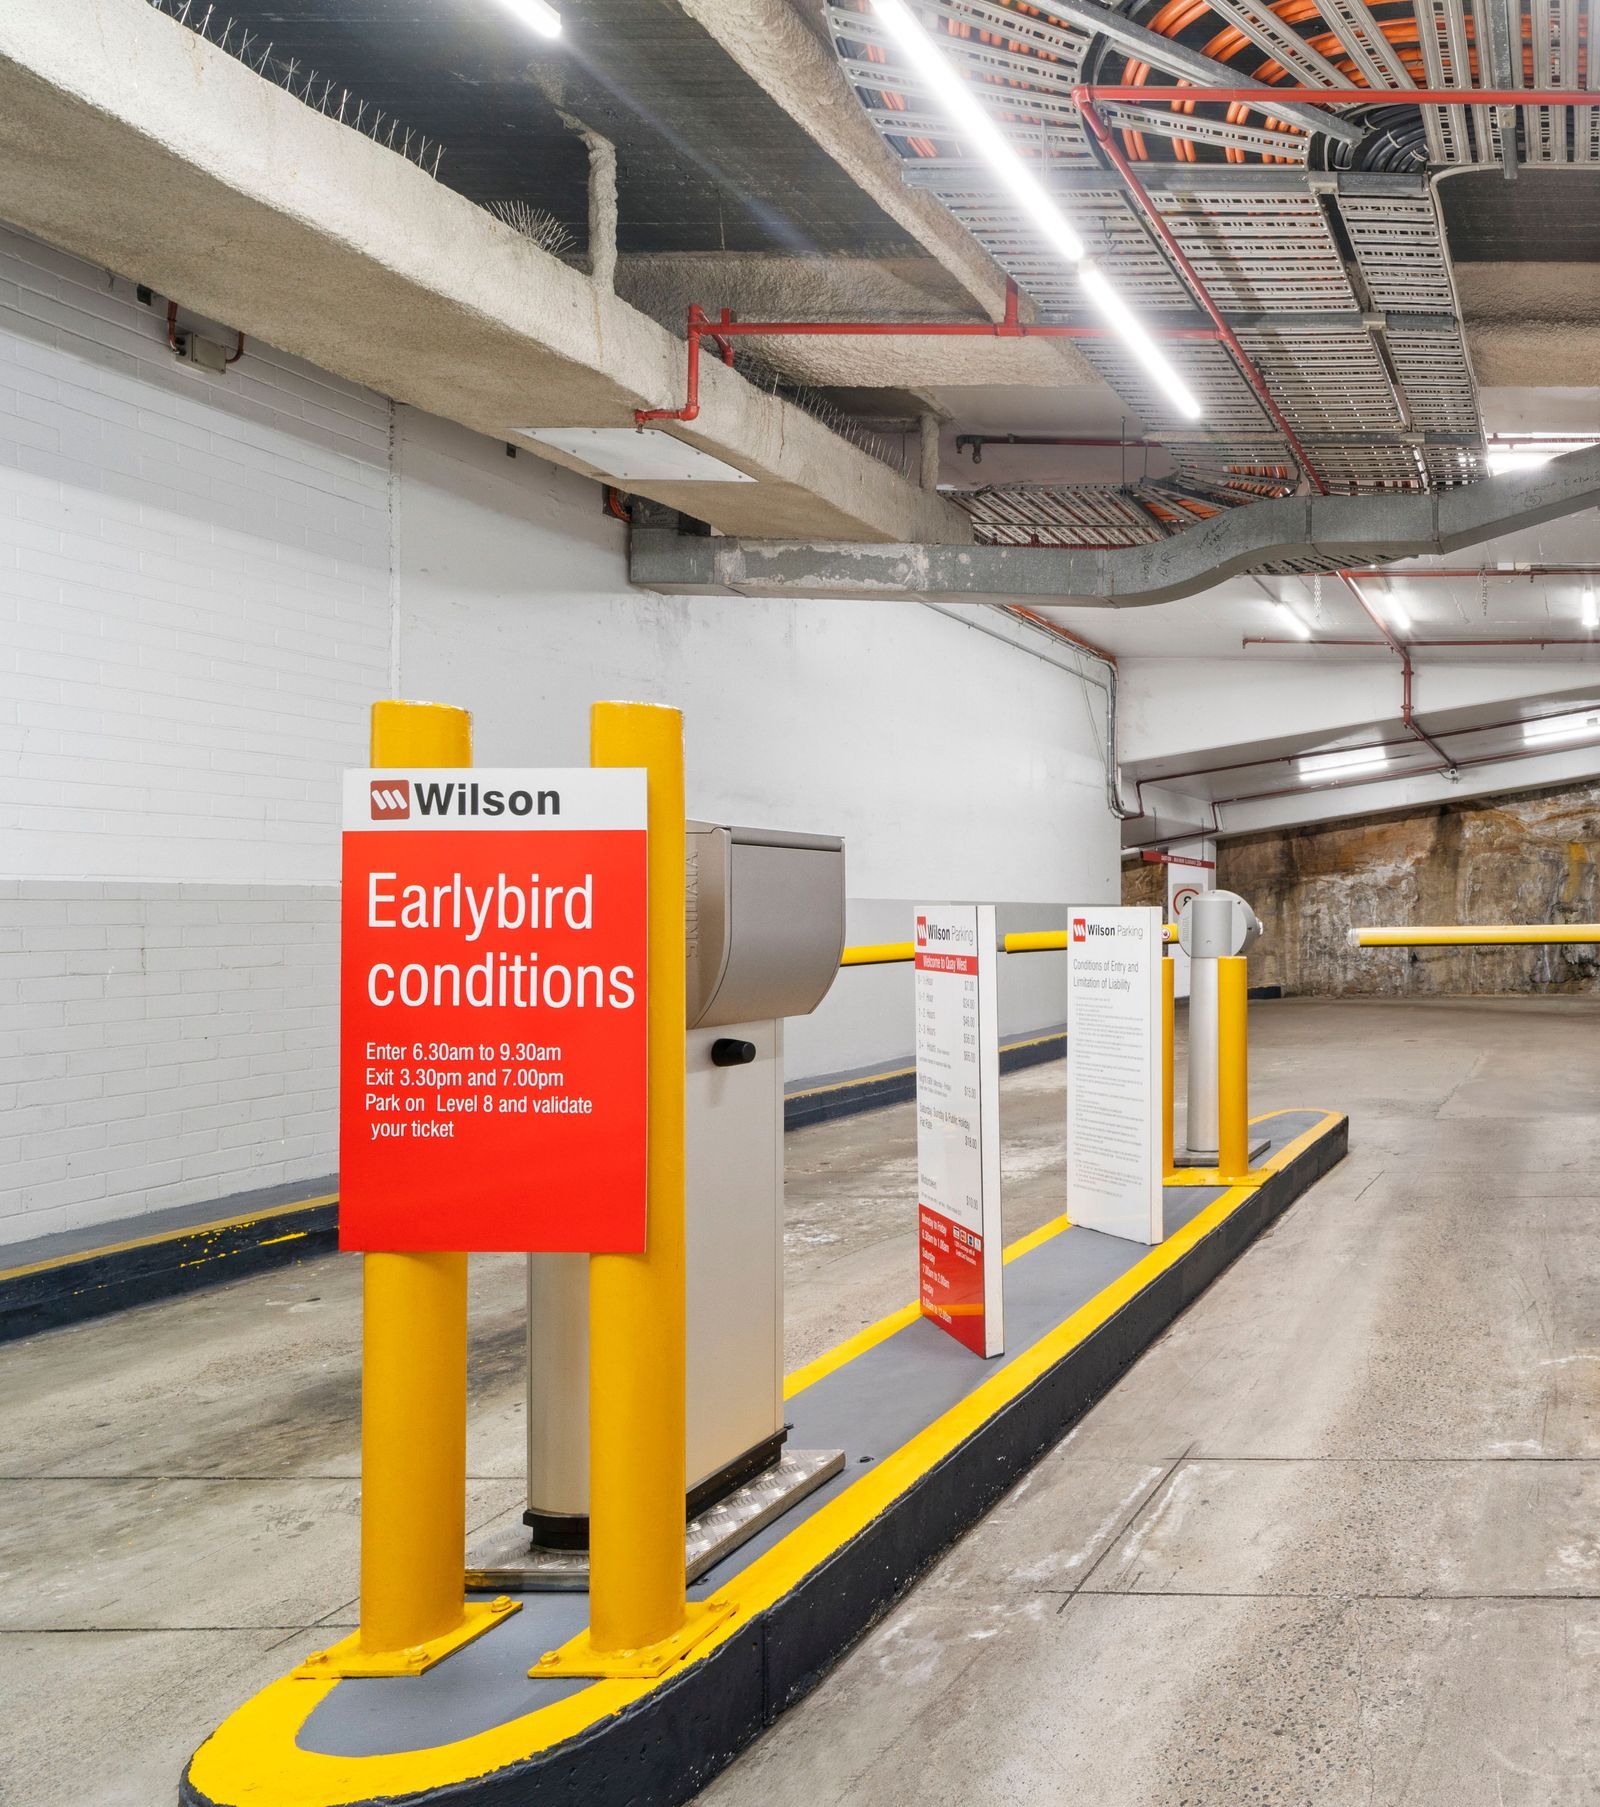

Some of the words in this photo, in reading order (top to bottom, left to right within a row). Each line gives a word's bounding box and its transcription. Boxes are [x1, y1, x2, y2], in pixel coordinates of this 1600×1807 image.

[415, 782, 561, 817] Wilson
[368, 872, 593, 942] Earlybird
[928, 924, 950, 941] Wilson
[951, 926, 974, 946] Parking
[1087, 924, 1115, 936] Wilson
[1117, 925, 1143, 940] Parking
[923, 955, 941, 969] Welcome
[941, 957, 945, 968] to
[946, 957, 955, 972] Quay
[956, 958, 967, 971] West
[1073, 959, 1102, 972] Conditions
[1104, 961, 1110, 971] of
[1111, 961, 1126, 974] Entry
[1128, 963, 1139, 973] and
[368, 952, 636, 1009] conditions
[1073, 976, 1100, 988] Limitation
[1102, 979, 1107, 989] of
[1109, 978, 1130, 992] Liability
[366, 1042, 407, 1062] Enter
[412, 1044, 474, 1062] 6.30am
[479, 1045, 495, 1062] to
[500, 1045, 561, 1062] 9.30am
[366, 1068, 394, 1087] Exit
[400, 1068, 462, 1090] 3.30pm
[468, 1070, 497, 1088] and
[502, 1070, 564, 1090] 7.00pm
[365, 1094, 400, 1112] Park
[405, 1097, 425, 1112] on
[437, 1094, 478, 1113] Level
[484, 1095, 493, 1113] 8
[499, 1096, 528, 1114] and
[533, 1096, 592, 1115] validate
[371, 1121, 407, 1141] your
[411, 1121, 454, 1138] ticket
